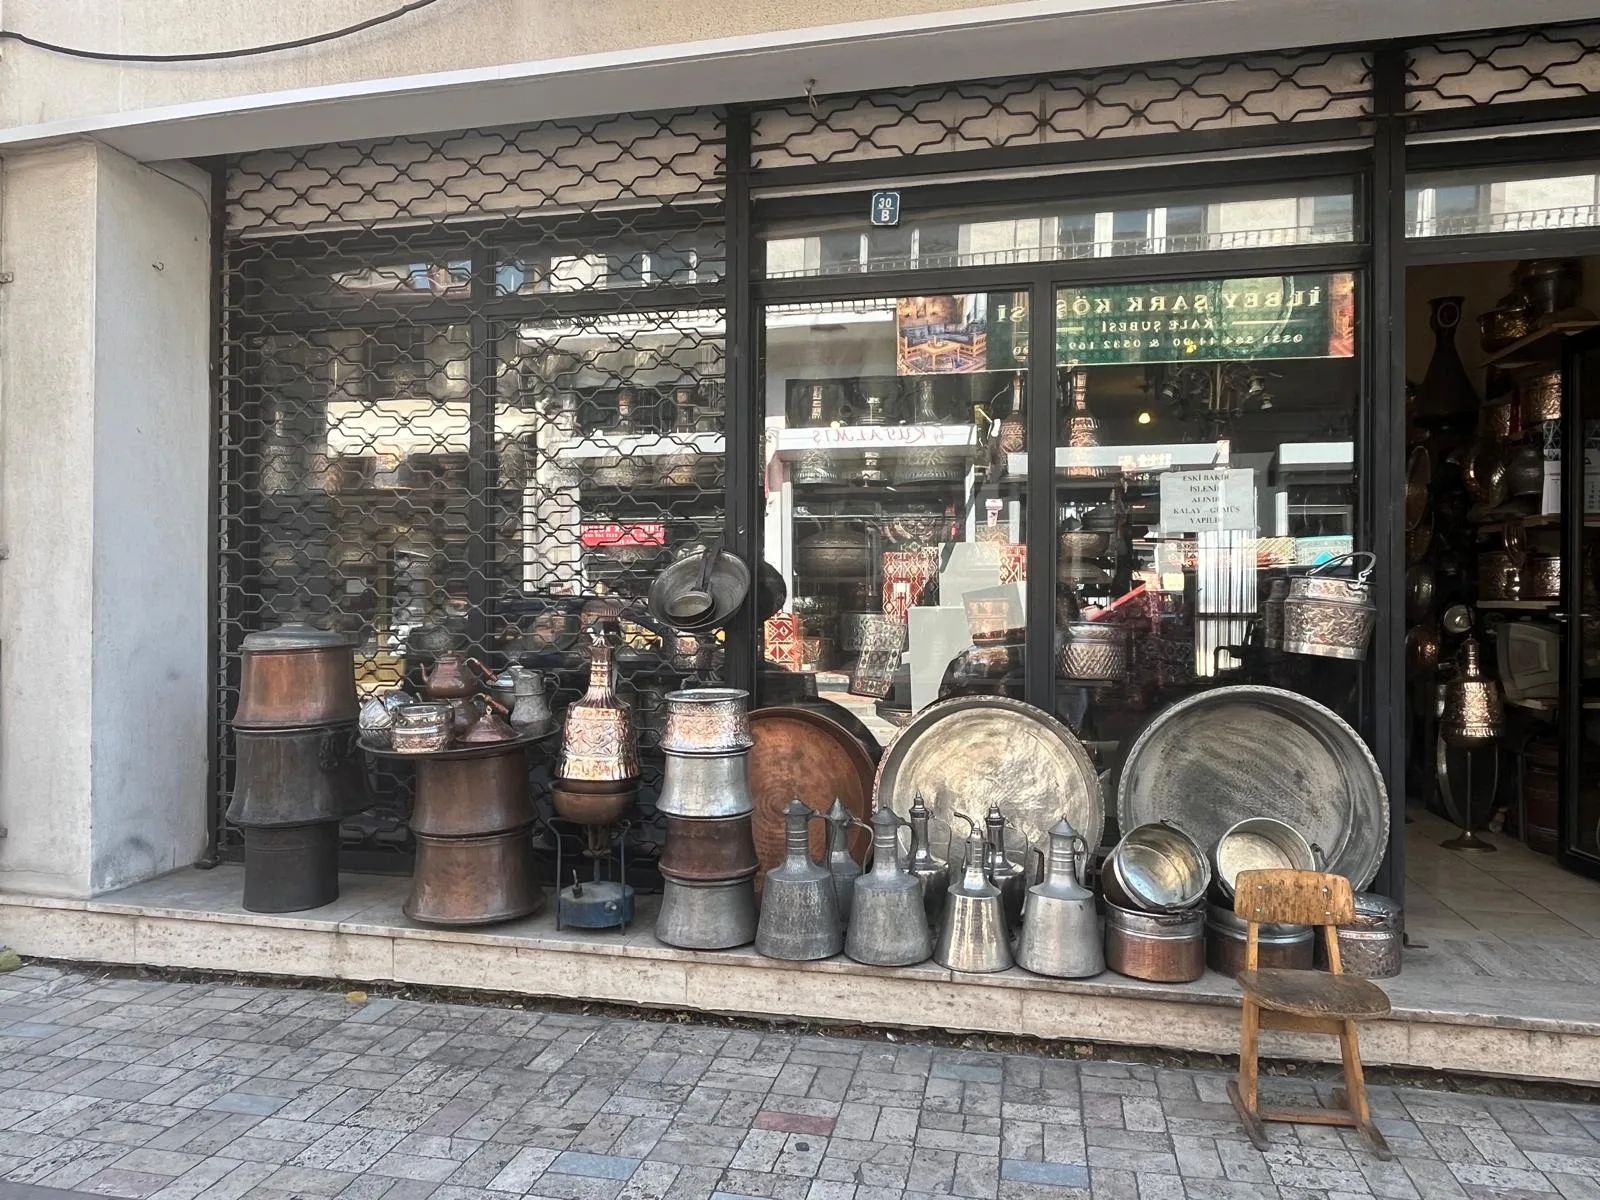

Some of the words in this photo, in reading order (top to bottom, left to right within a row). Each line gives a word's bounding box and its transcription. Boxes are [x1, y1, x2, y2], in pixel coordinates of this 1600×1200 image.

[878, 197, 892, 208] 30
[881, 209, 890, 221] B
[1173, 507, 1201, 515] KALAY
